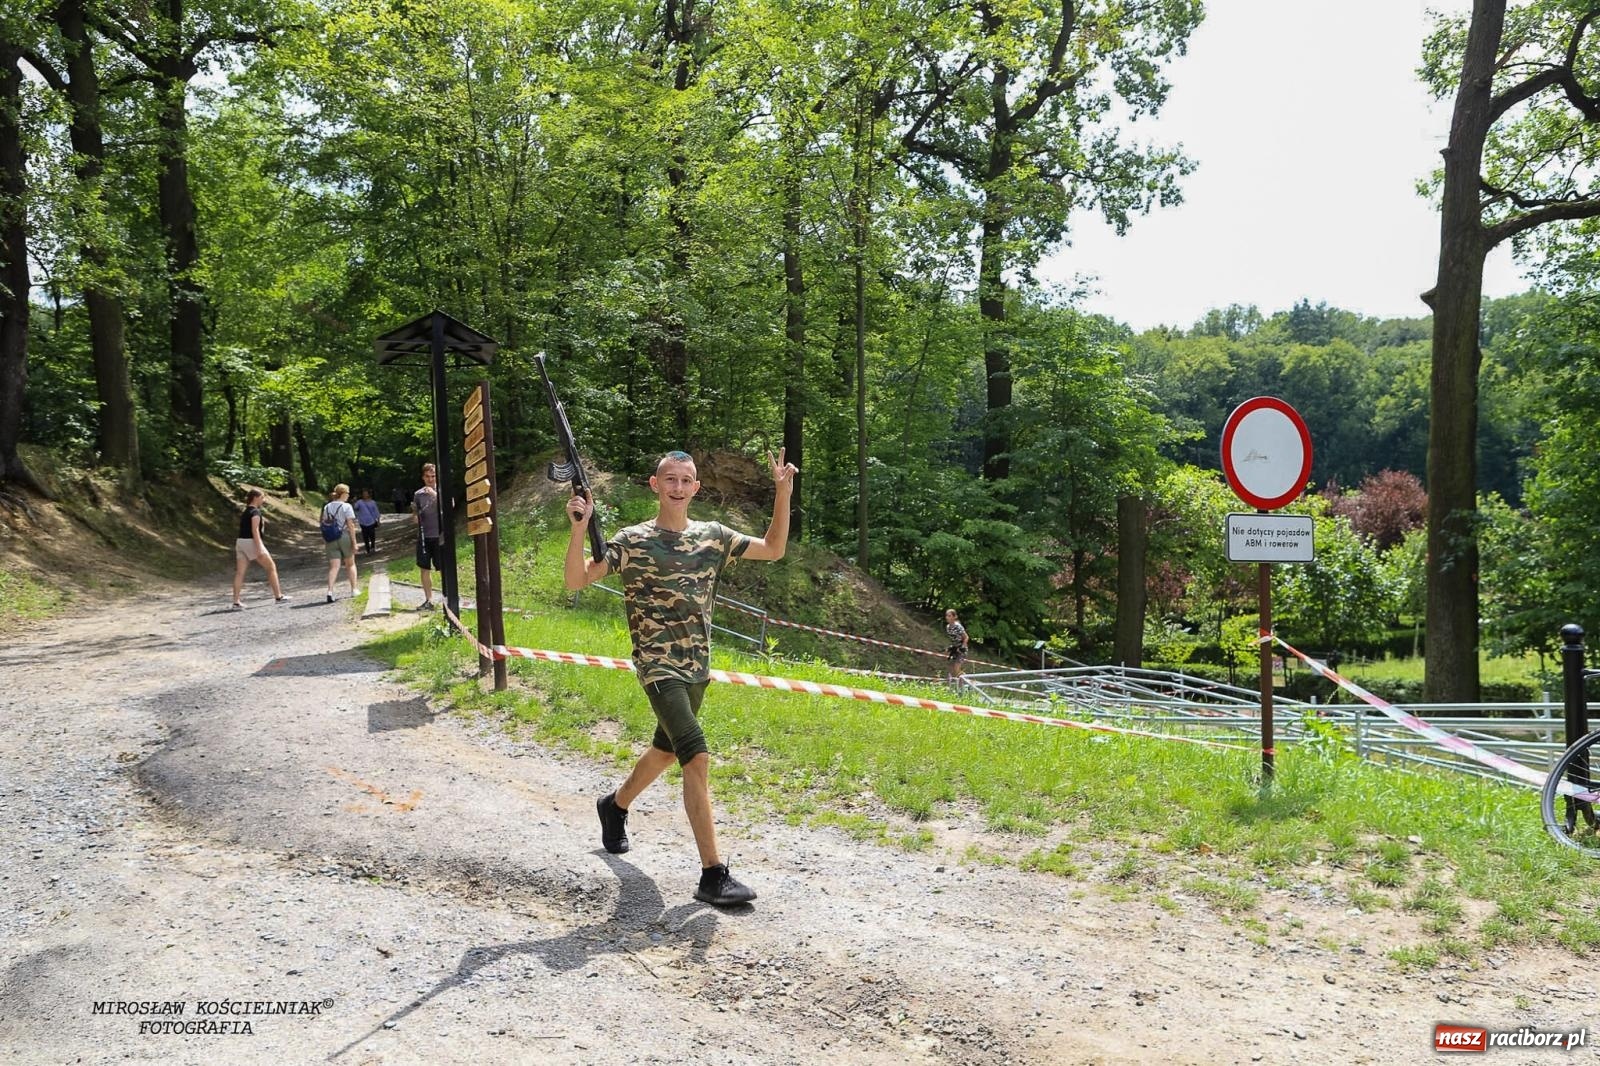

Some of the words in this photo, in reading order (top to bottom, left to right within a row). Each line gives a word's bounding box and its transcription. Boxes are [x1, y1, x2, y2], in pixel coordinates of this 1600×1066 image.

[1232, 526, 1245, 535] Nie
[1247, 527, 1275, 537] dotyczy
[1245, 539, 1262, 547] ABM
